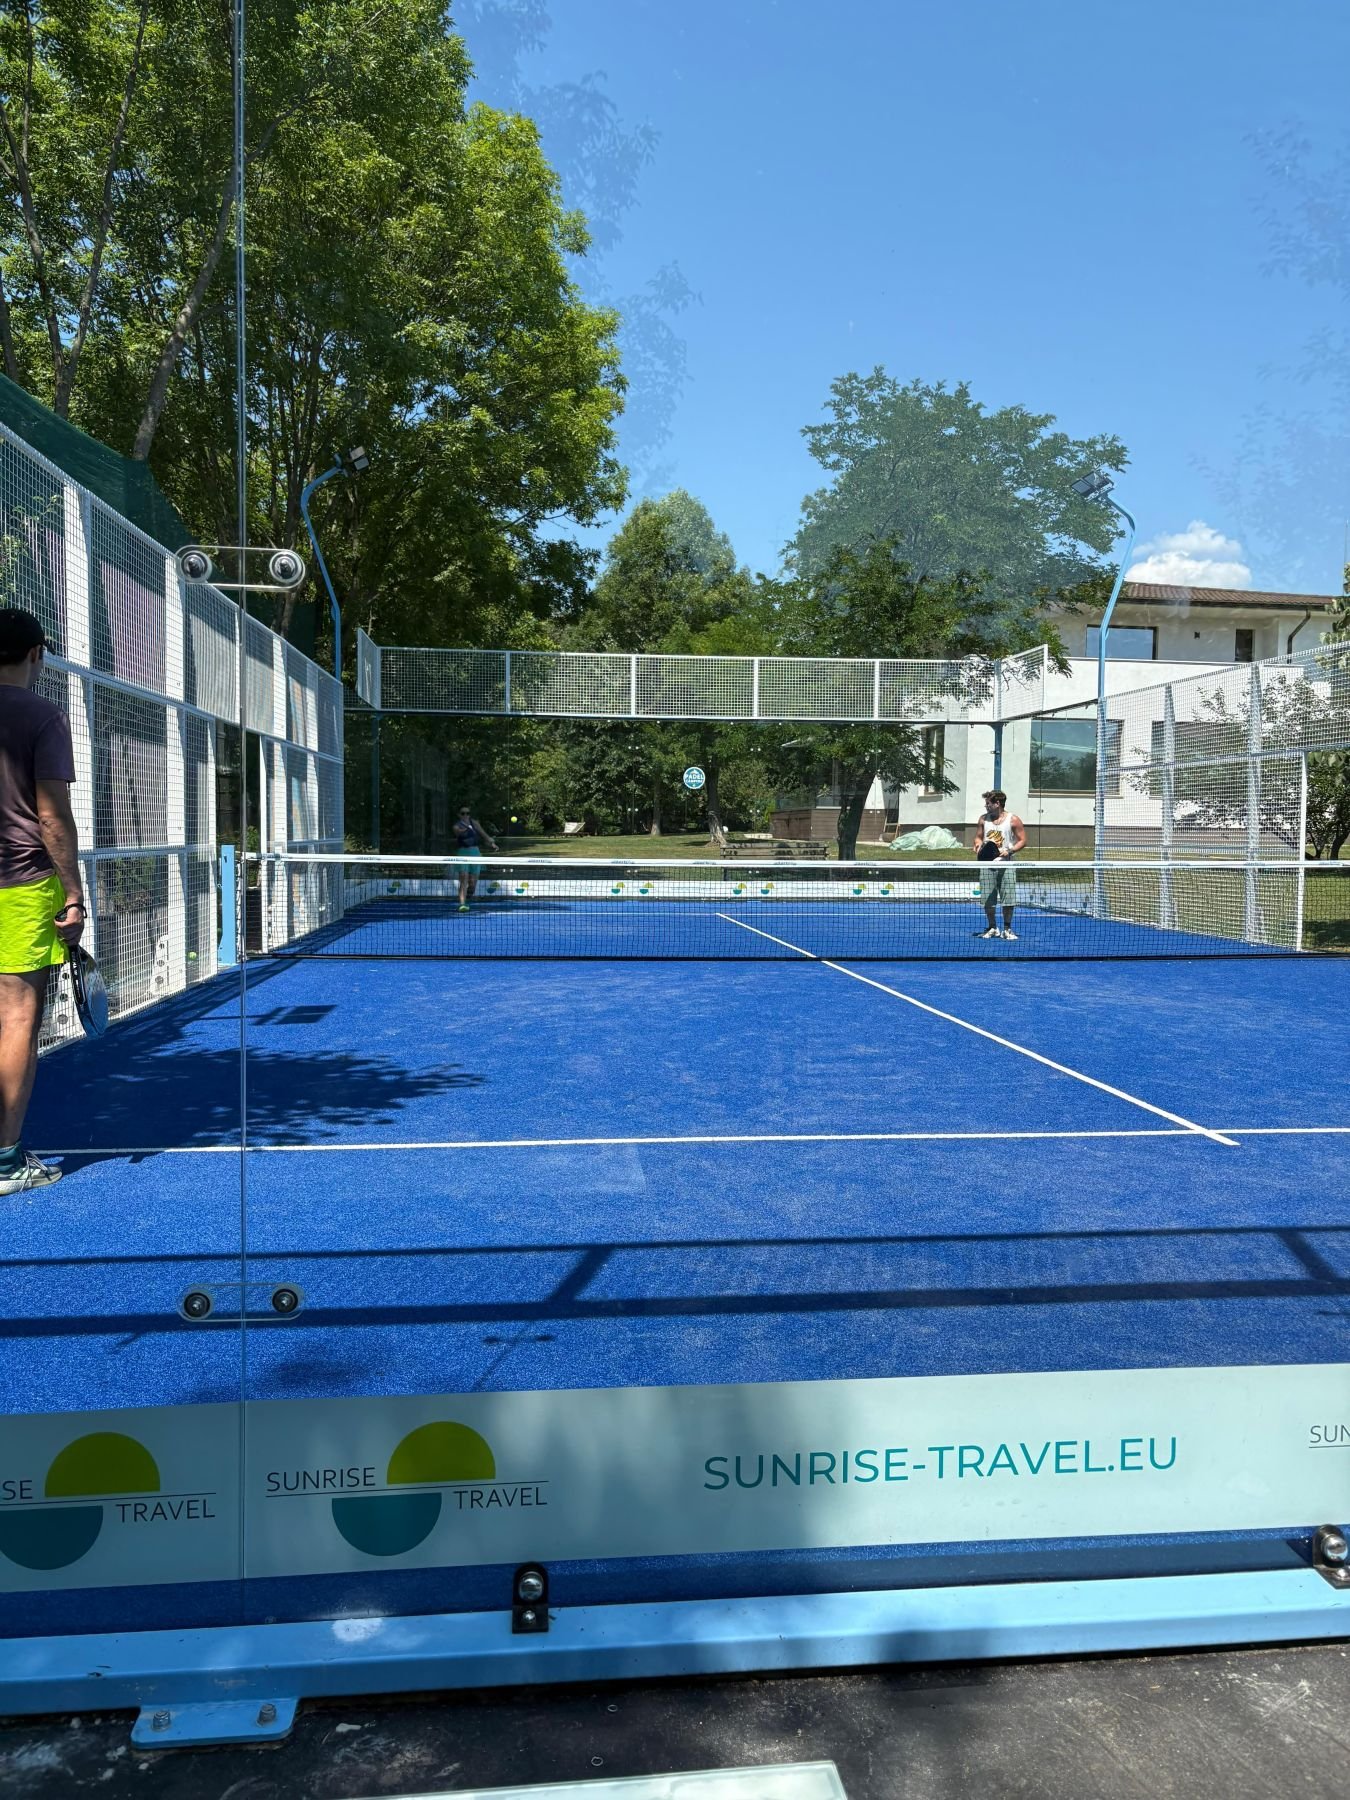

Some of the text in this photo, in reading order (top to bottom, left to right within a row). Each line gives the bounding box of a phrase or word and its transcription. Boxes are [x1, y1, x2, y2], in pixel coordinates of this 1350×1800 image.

[703, 1435, 1178, 1491] SUNRISE-TRAVEL.EU
[267, 1466, 377, 1492] SUNRISE
[115, 1498, 216, 1524] TRAVEL
[454, 1486, 548, 1511] TRAVEL
